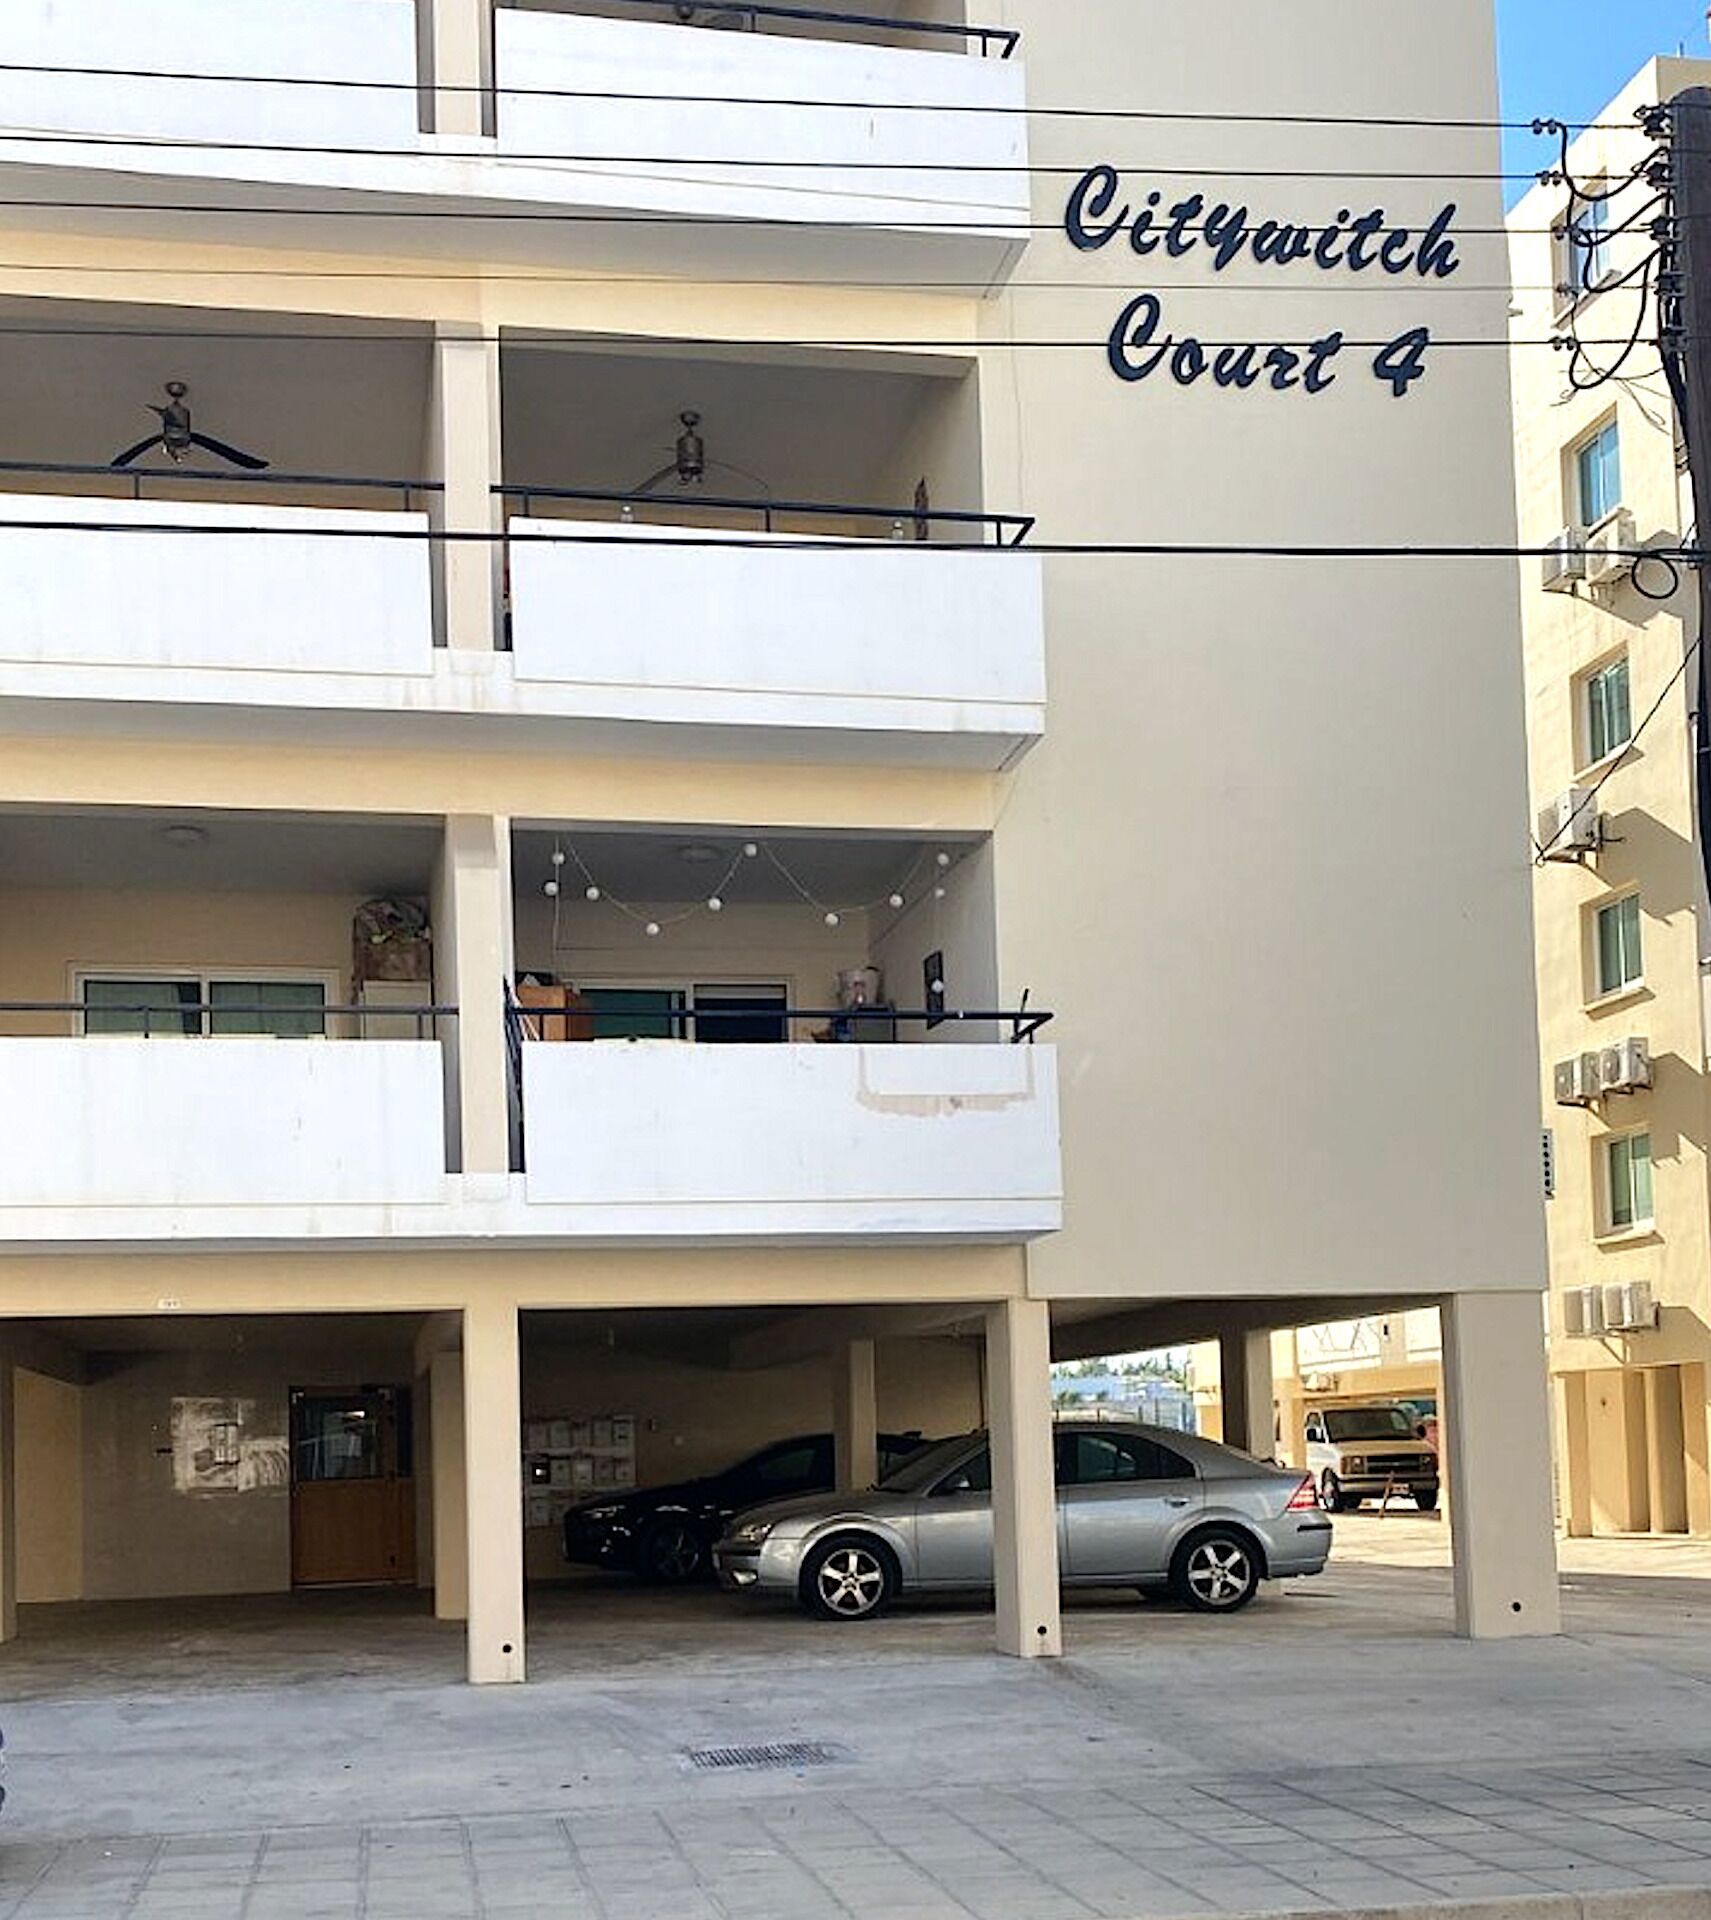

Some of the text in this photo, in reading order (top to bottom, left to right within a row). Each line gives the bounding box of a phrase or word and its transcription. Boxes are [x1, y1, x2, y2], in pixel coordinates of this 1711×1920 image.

[1064, 165, 1460, 278] Citywitch
[1107, 293, 1429, 397] Court 4
